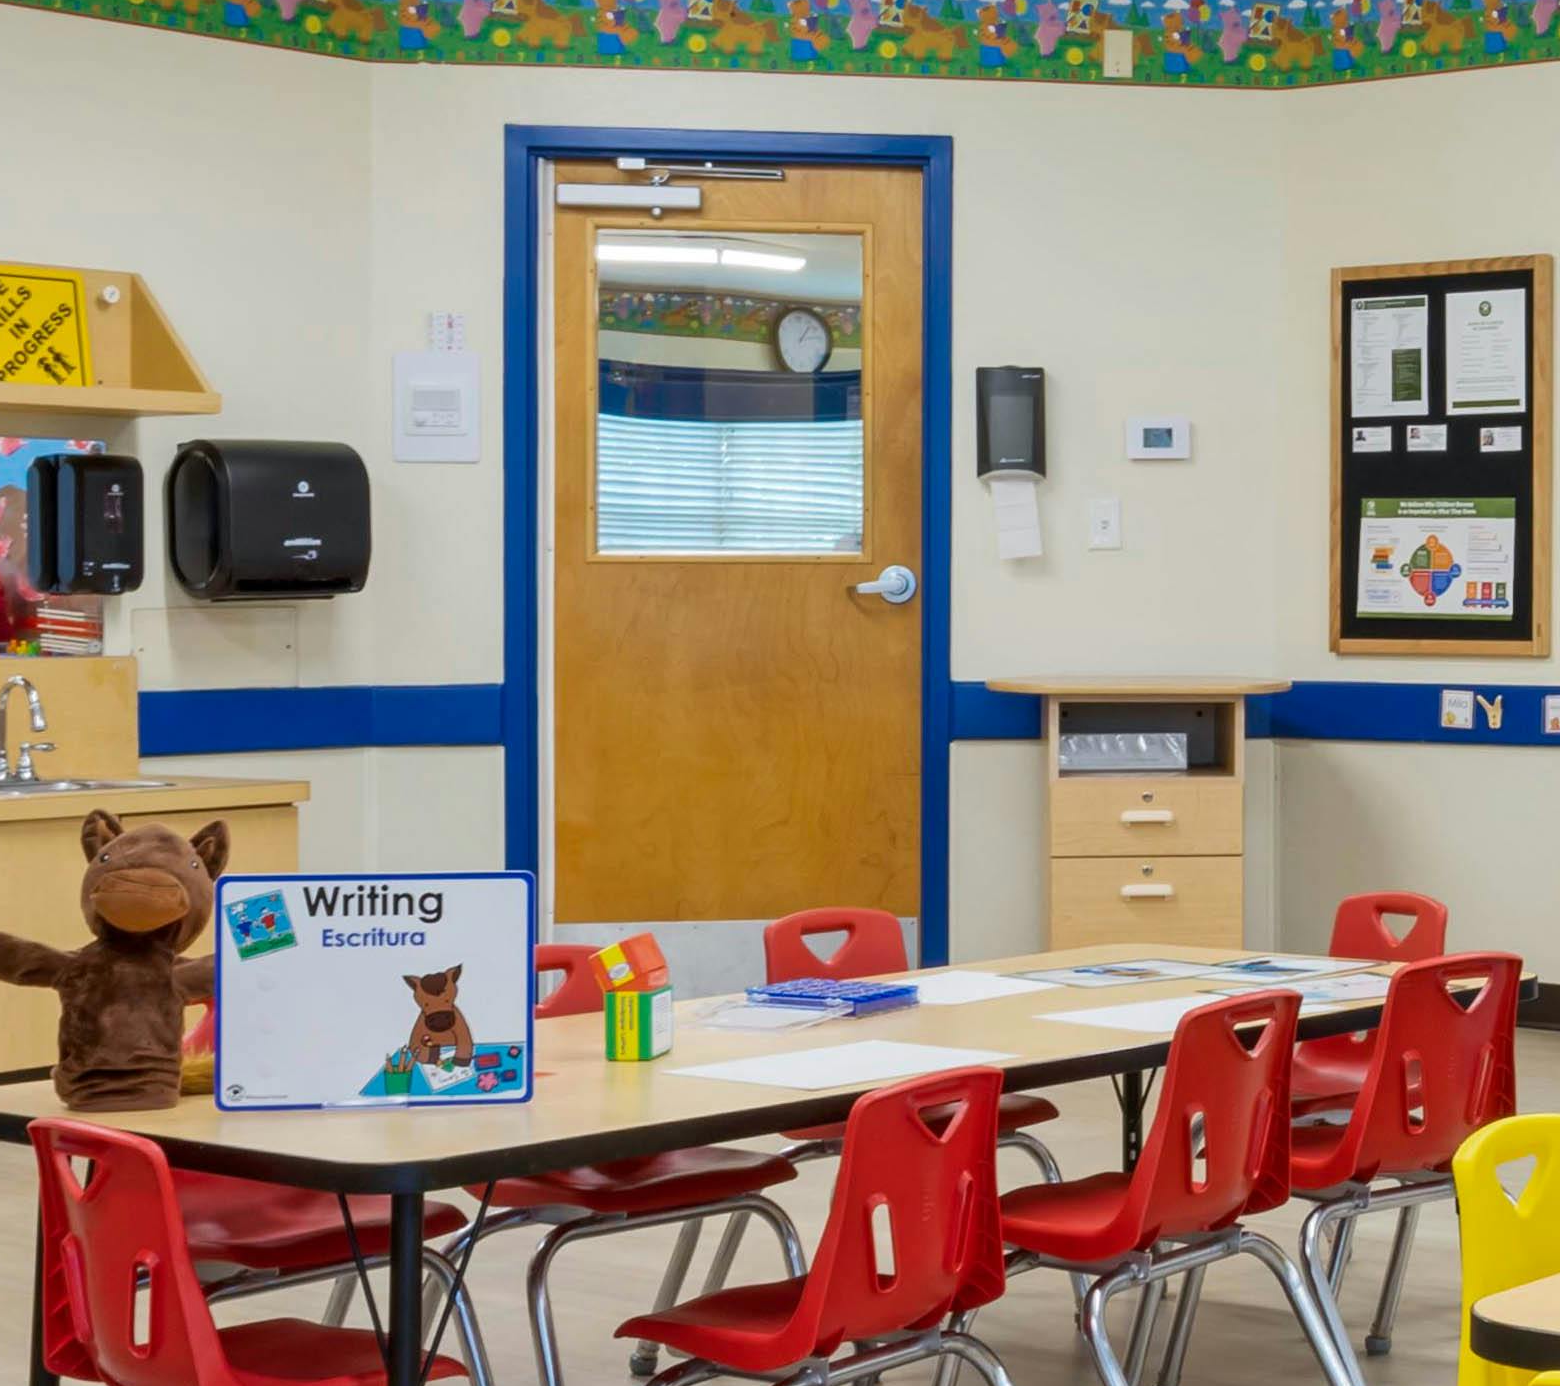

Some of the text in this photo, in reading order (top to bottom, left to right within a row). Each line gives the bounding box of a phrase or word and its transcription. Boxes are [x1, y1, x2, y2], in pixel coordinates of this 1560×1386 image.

[8, 317, 31, 340] IN
[302, 884, 444, 924] Writing
[321, 928, 427, 948] Escritura
